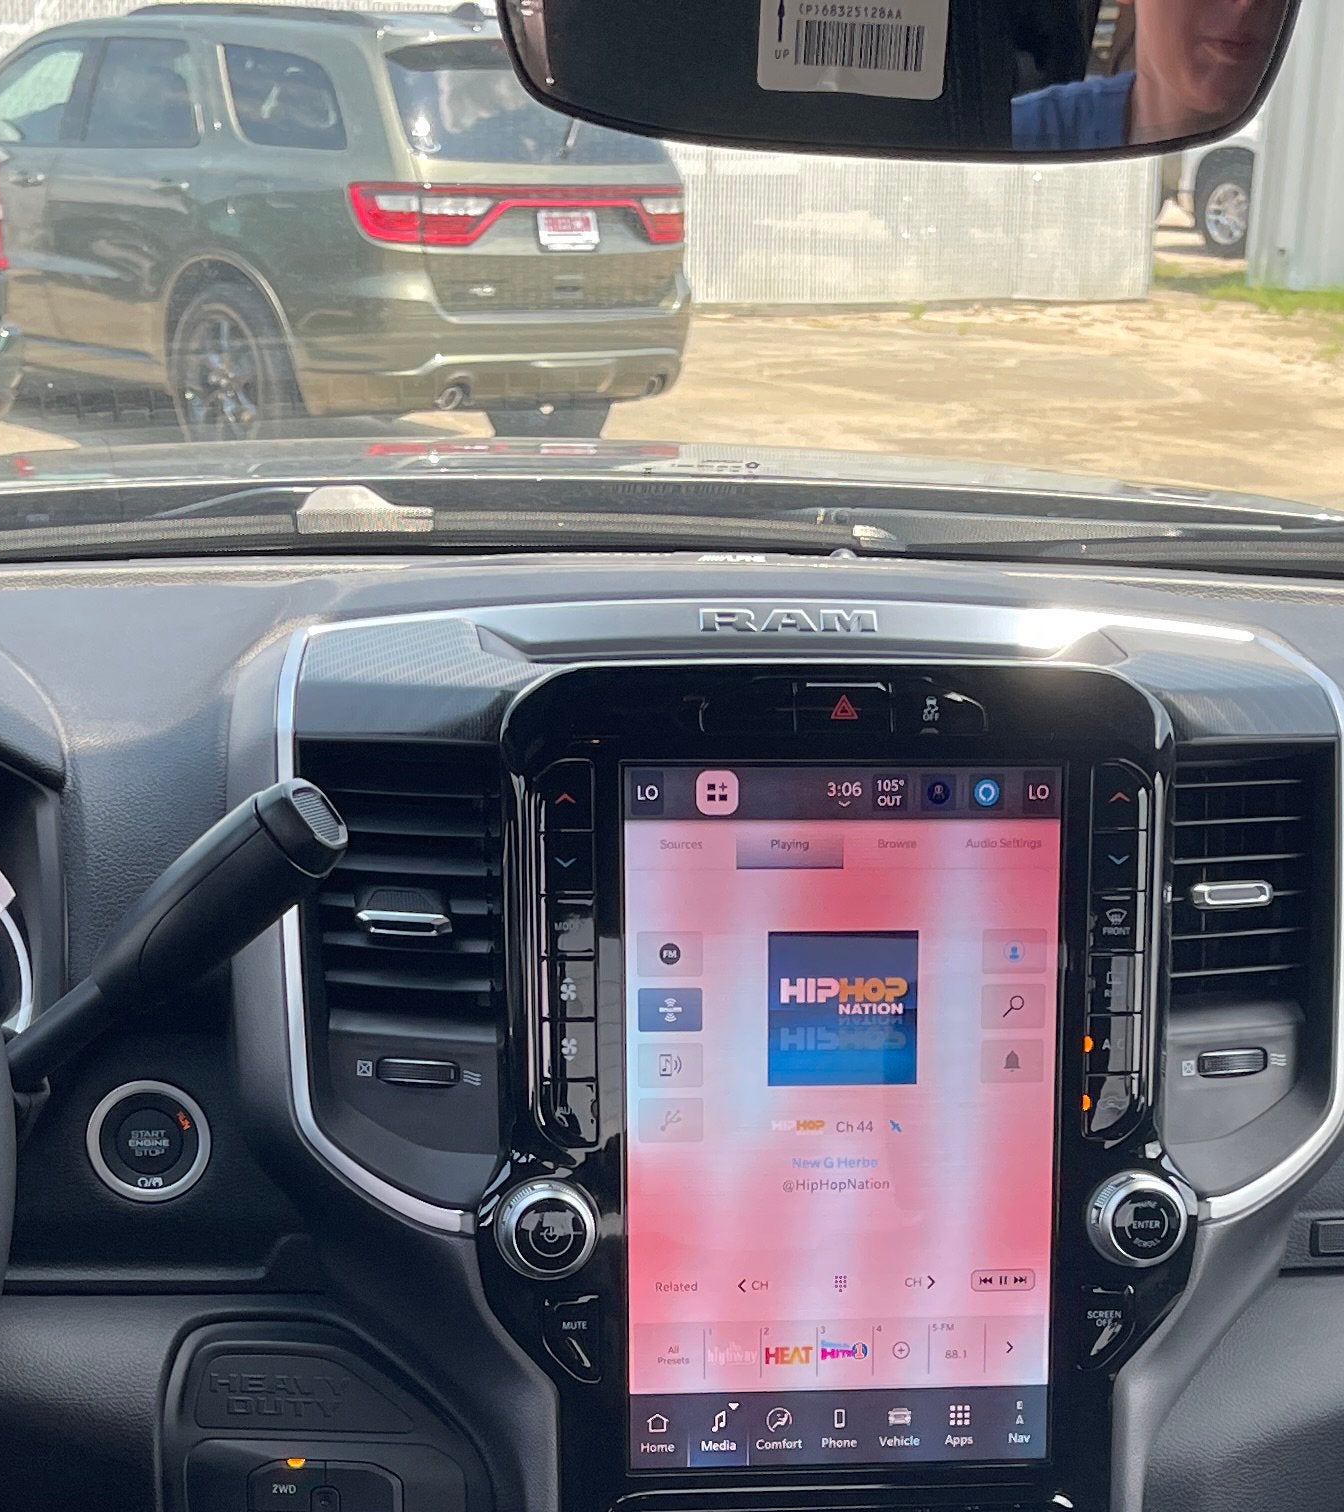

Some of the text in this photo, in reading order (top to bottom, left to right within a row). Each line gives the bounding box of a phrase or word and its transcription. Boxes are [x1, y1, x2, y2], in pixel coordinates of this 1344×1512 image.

[774, 49, 790, 60] UP
[699, 607, 879, 632] RAM
[637, 784, 659, 801] LO
[827, 781, 863, 798] 3:06
[1028, 784, 1050, 801] LO
[877, 796, 902, 808] OUT
[659, 838, 704, 851] Sources
[770, 838, 810, 852] Playing
[877, 838, 917, 850] Browse
[965, 837, 1043, 851] Audio Settings
[1102, 926, 1131, 936] FRONT
[662, 949, 677, 959] FM
[838, 1002, 904, 1016] NATION
[836, 1120, 854, 1133] Ch
[856, 1120, 874, 1133] 44
[131, 1130, 167, 1139] START
[128, 1138, 170, 1148] ENGINE
[135, 1149, 166, 1157] STOP
[791, 1156, 879, 1169] New G Herbo
[782, 1178, 891, 1193] @HipHopNation
[1132, 1219, 1161, 1230] ENTER
[655, 1280, 699, 1293] Related
[751, 1279, 769, 1291] CH
[904, 1277, 923, 1288] CH
[1086, 1310, 1123, 1320] SCREEN
[562, 1320, 588, 1331] MUTE
[763, 1327, 770, 1336] 2
[820, 1325, 827, 1335] 3
[875, 1324, 883, 1333] 4
[667, 1345, 680, 1355] All
[764, 1345, 814, 1365] HEAT
[944, 1349, 968, 1360] 88.1
[657, 1356, 690, 1366] Presets
[208, 1373, 346, 1396] HEAVY
[226, 1395, 341, 1418] DUTY
[821, 1437, 858, 1448] Phone
[878, 1434, 921, 1447] Vehicle
[944, 1434, 974, 1448] Apps
[1008, 1432, 1031, 1443] Nav
[640, 1442, 676, 1453] Home
[701, 1440, 737, 1452] Media
[756, 1438, 803, 1450] Comfort
[272, 1484, 297, 1494] 2WD
